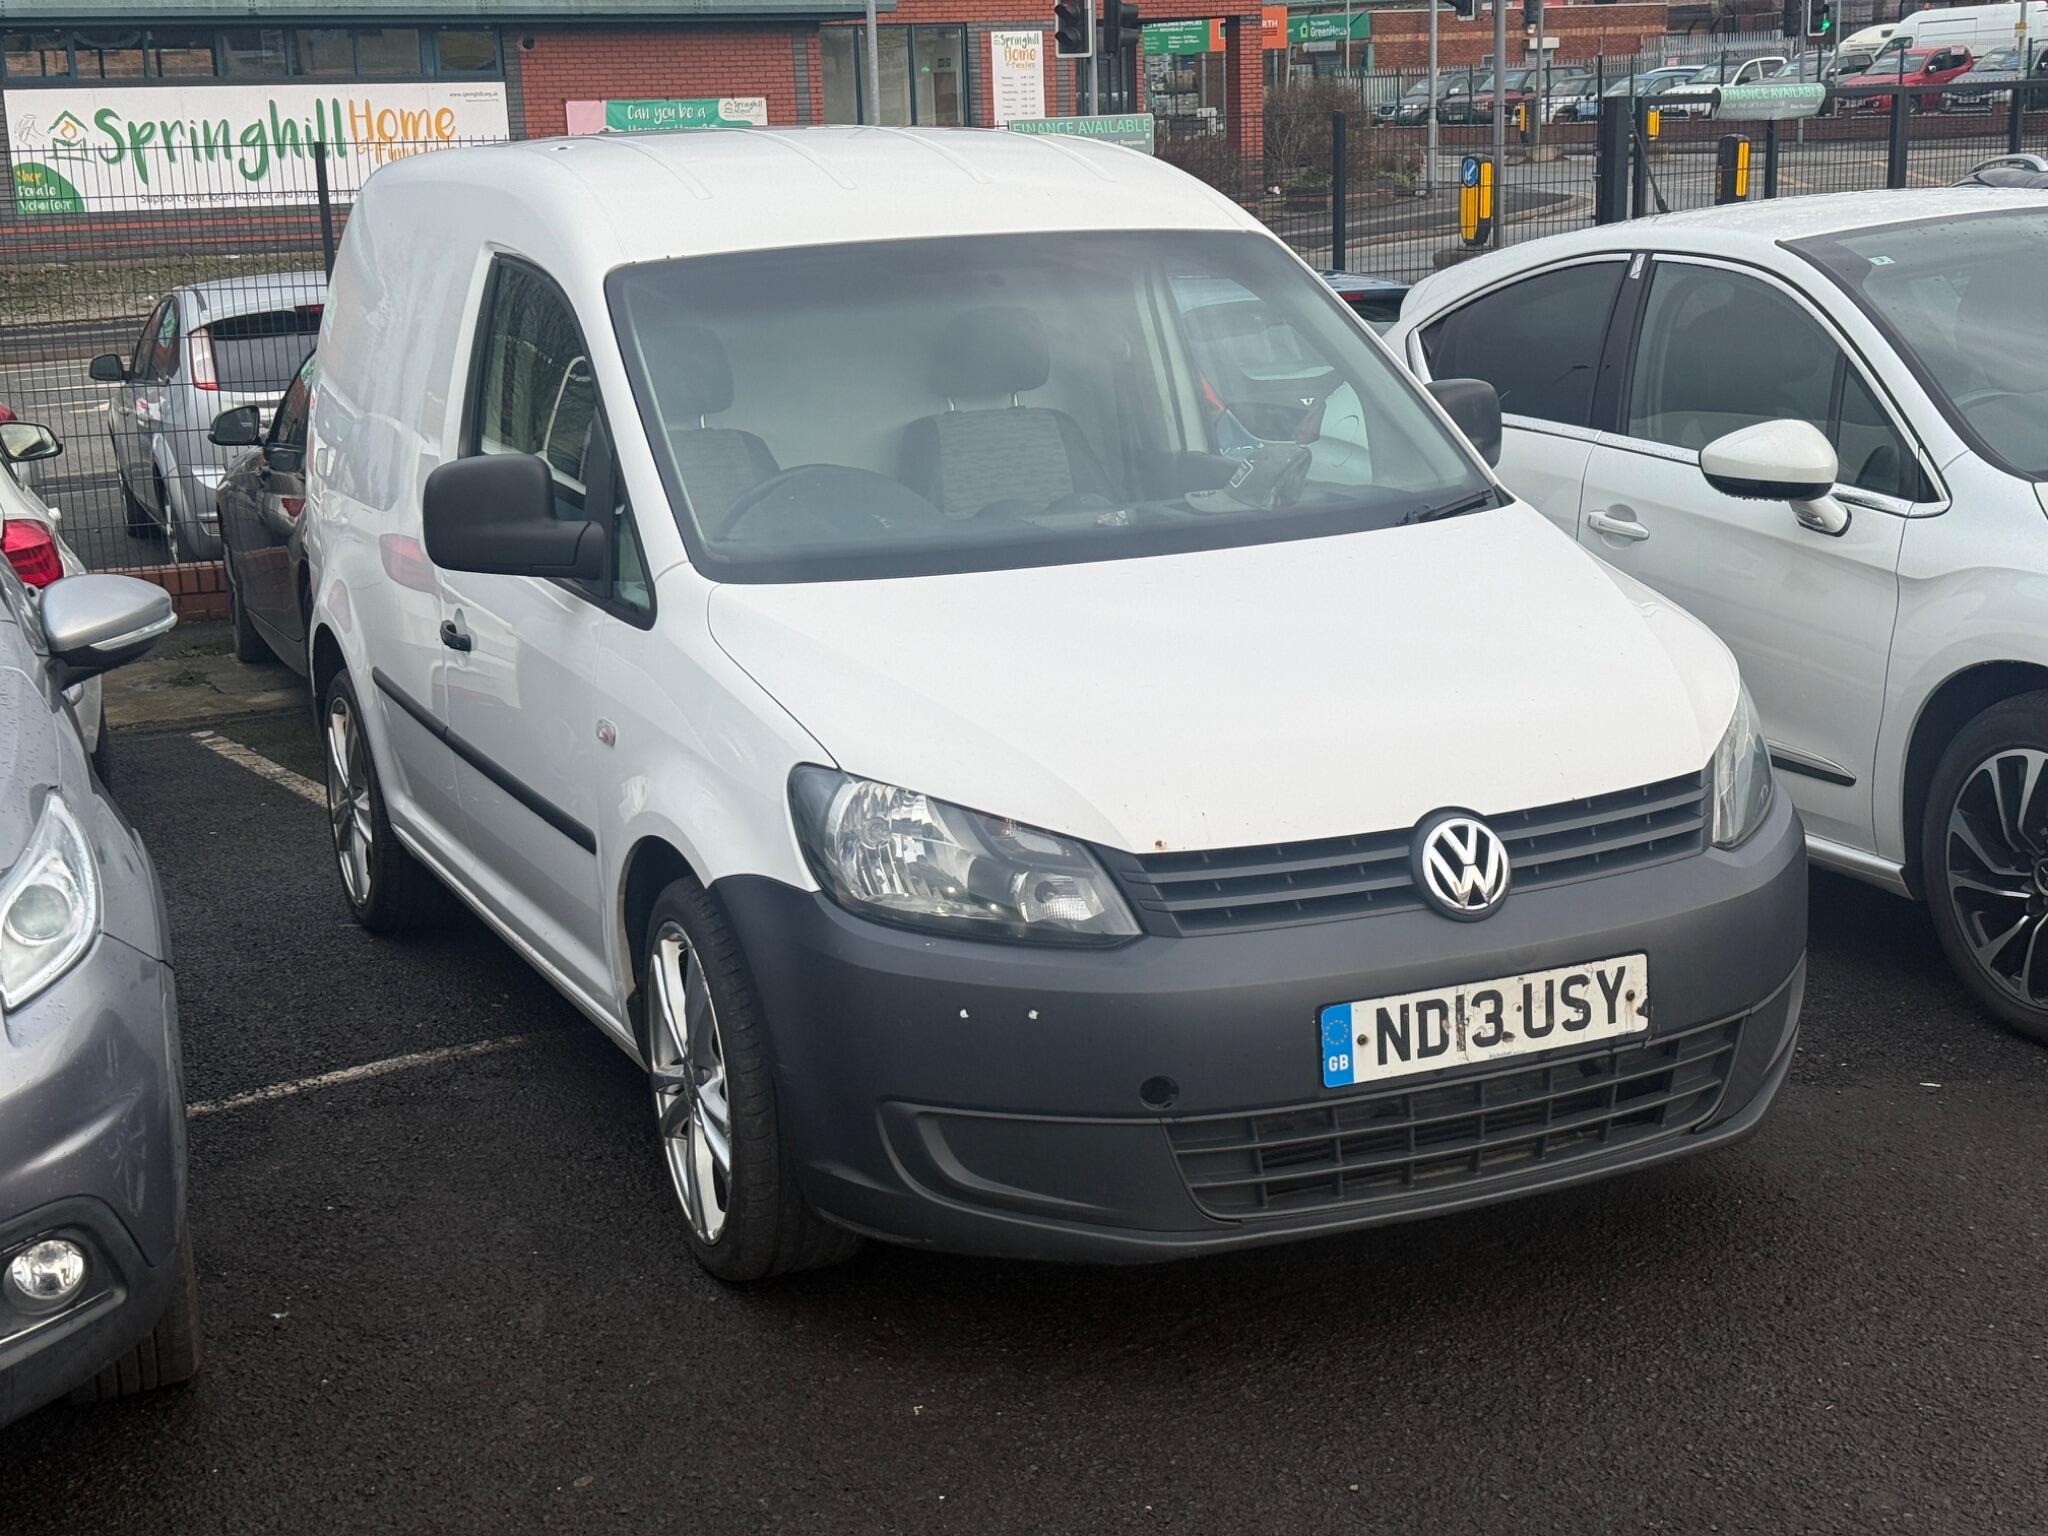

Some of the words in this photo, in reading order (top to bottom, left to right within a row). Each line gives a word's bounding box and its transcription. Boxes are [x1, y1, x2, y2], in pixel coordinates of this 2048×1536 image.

[1310, 26, 1347, 37] GreenHous
[1000, 33, 1039, 49] Springhill
[1004, 46, 1036, 61] Home
[627, 104, 650, 120] Can
[653, 106, 676, 124] you
[679, 103, 694, 119] be
[698, 105, 706, 119] a
[1012, 121, 1075, 135] FINANCE
[1078, 118, 1152, 134] AVAILABLE
[94, 98, 349, 186] Springhill
[348, 98, 456, 141] Home
[1376, 988, 1505, 1066] ND13
[1522, 966, 1626, 1039] USY
[1328, 1054, 1349, 1072] GB
